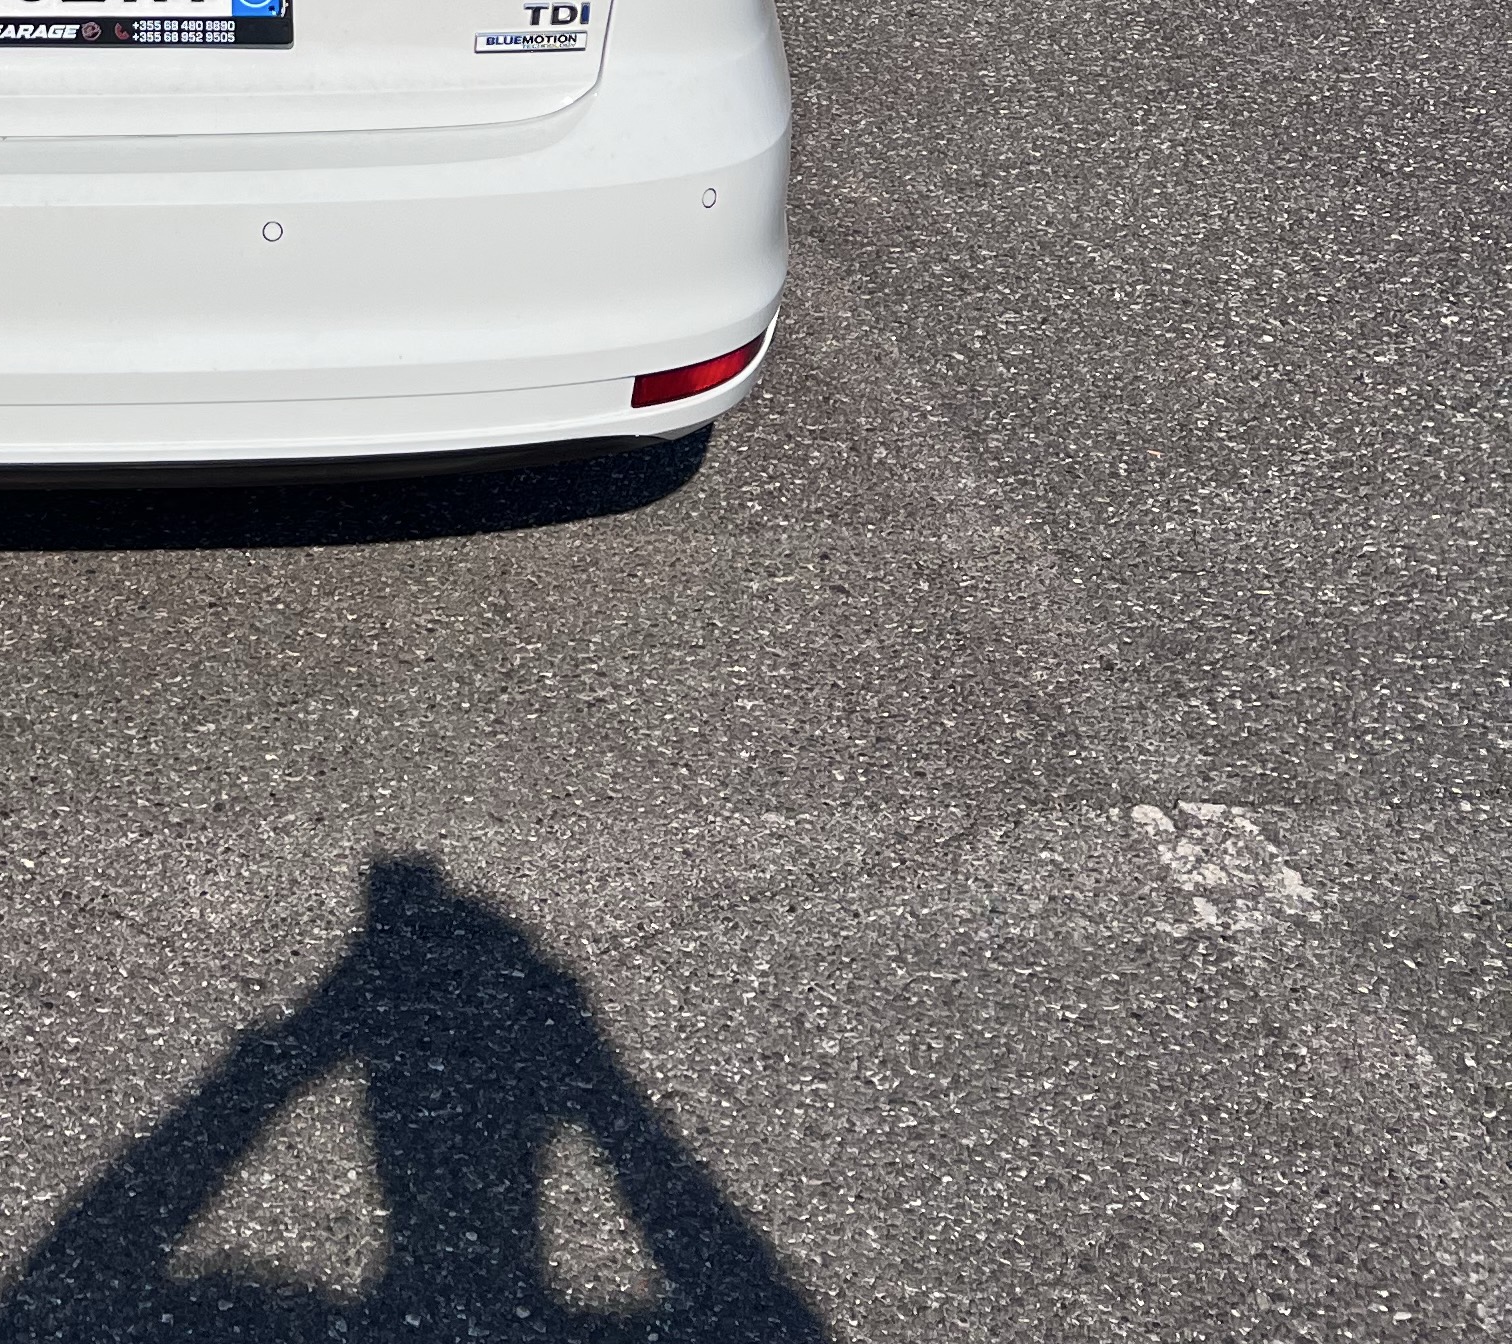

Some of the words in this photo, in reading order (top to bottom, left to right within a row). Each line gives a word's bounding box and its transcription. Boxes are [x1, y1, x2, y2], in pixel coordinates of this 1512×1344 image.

[523, 1, 591, 26] TDI
[132, 20, 161, 31] +355
[132, 32, 161, 43] +355
[181, 32, 204, 43] 952
[206, 32, 236, 43] 9505
[485, 34, 578, 47] BLUEMOTION
